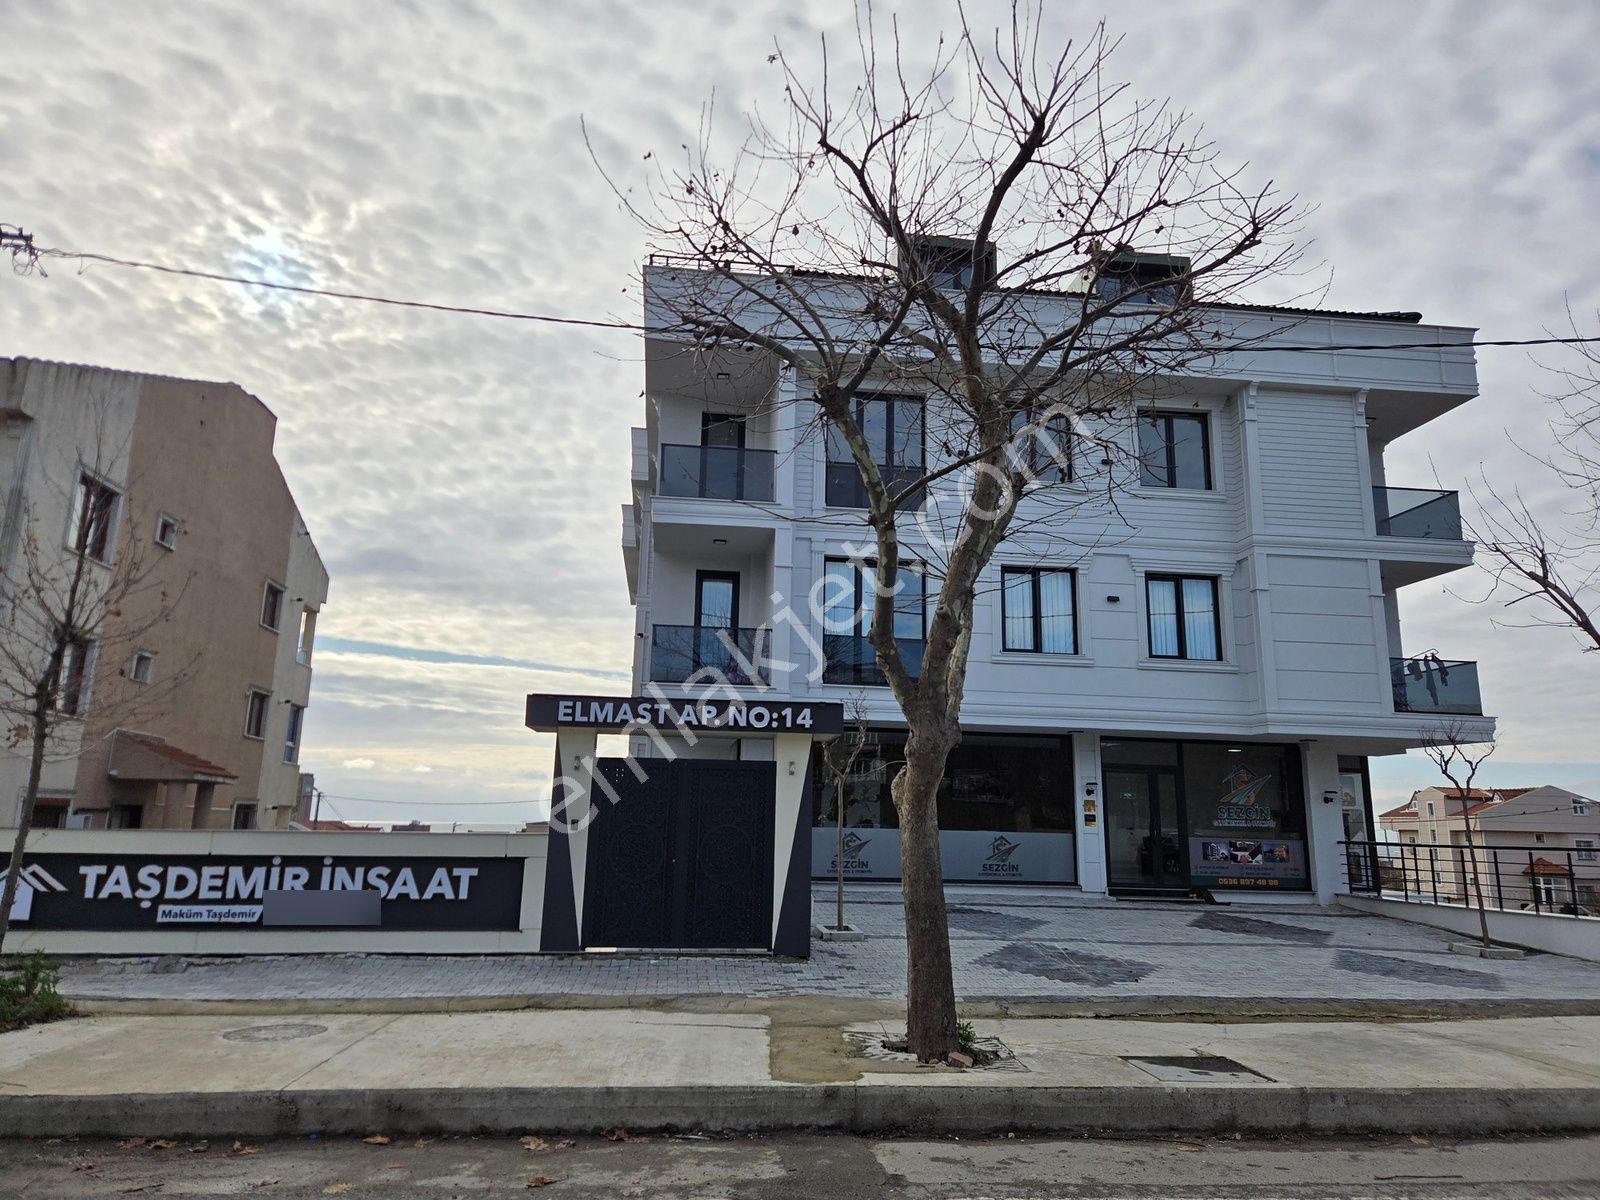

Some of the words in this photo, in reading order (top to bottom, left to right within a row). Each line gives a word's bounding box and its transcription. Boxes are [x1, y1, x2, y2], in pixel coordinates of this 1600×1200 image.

[557, 701, 671, 725] ELMAST
[677, 704, 720, 727] AP.
[728, 706, 813, 729] NO:14
[1217, 804, 1271, 820] SEZGİN
[831, 858, 869, 869] SZGİN
[982, 862, 1019, 872] SEZGİN
[79, 856, 310, 909] TAŞDEMİR
[206, 908, 257, 921] Taşdemir
